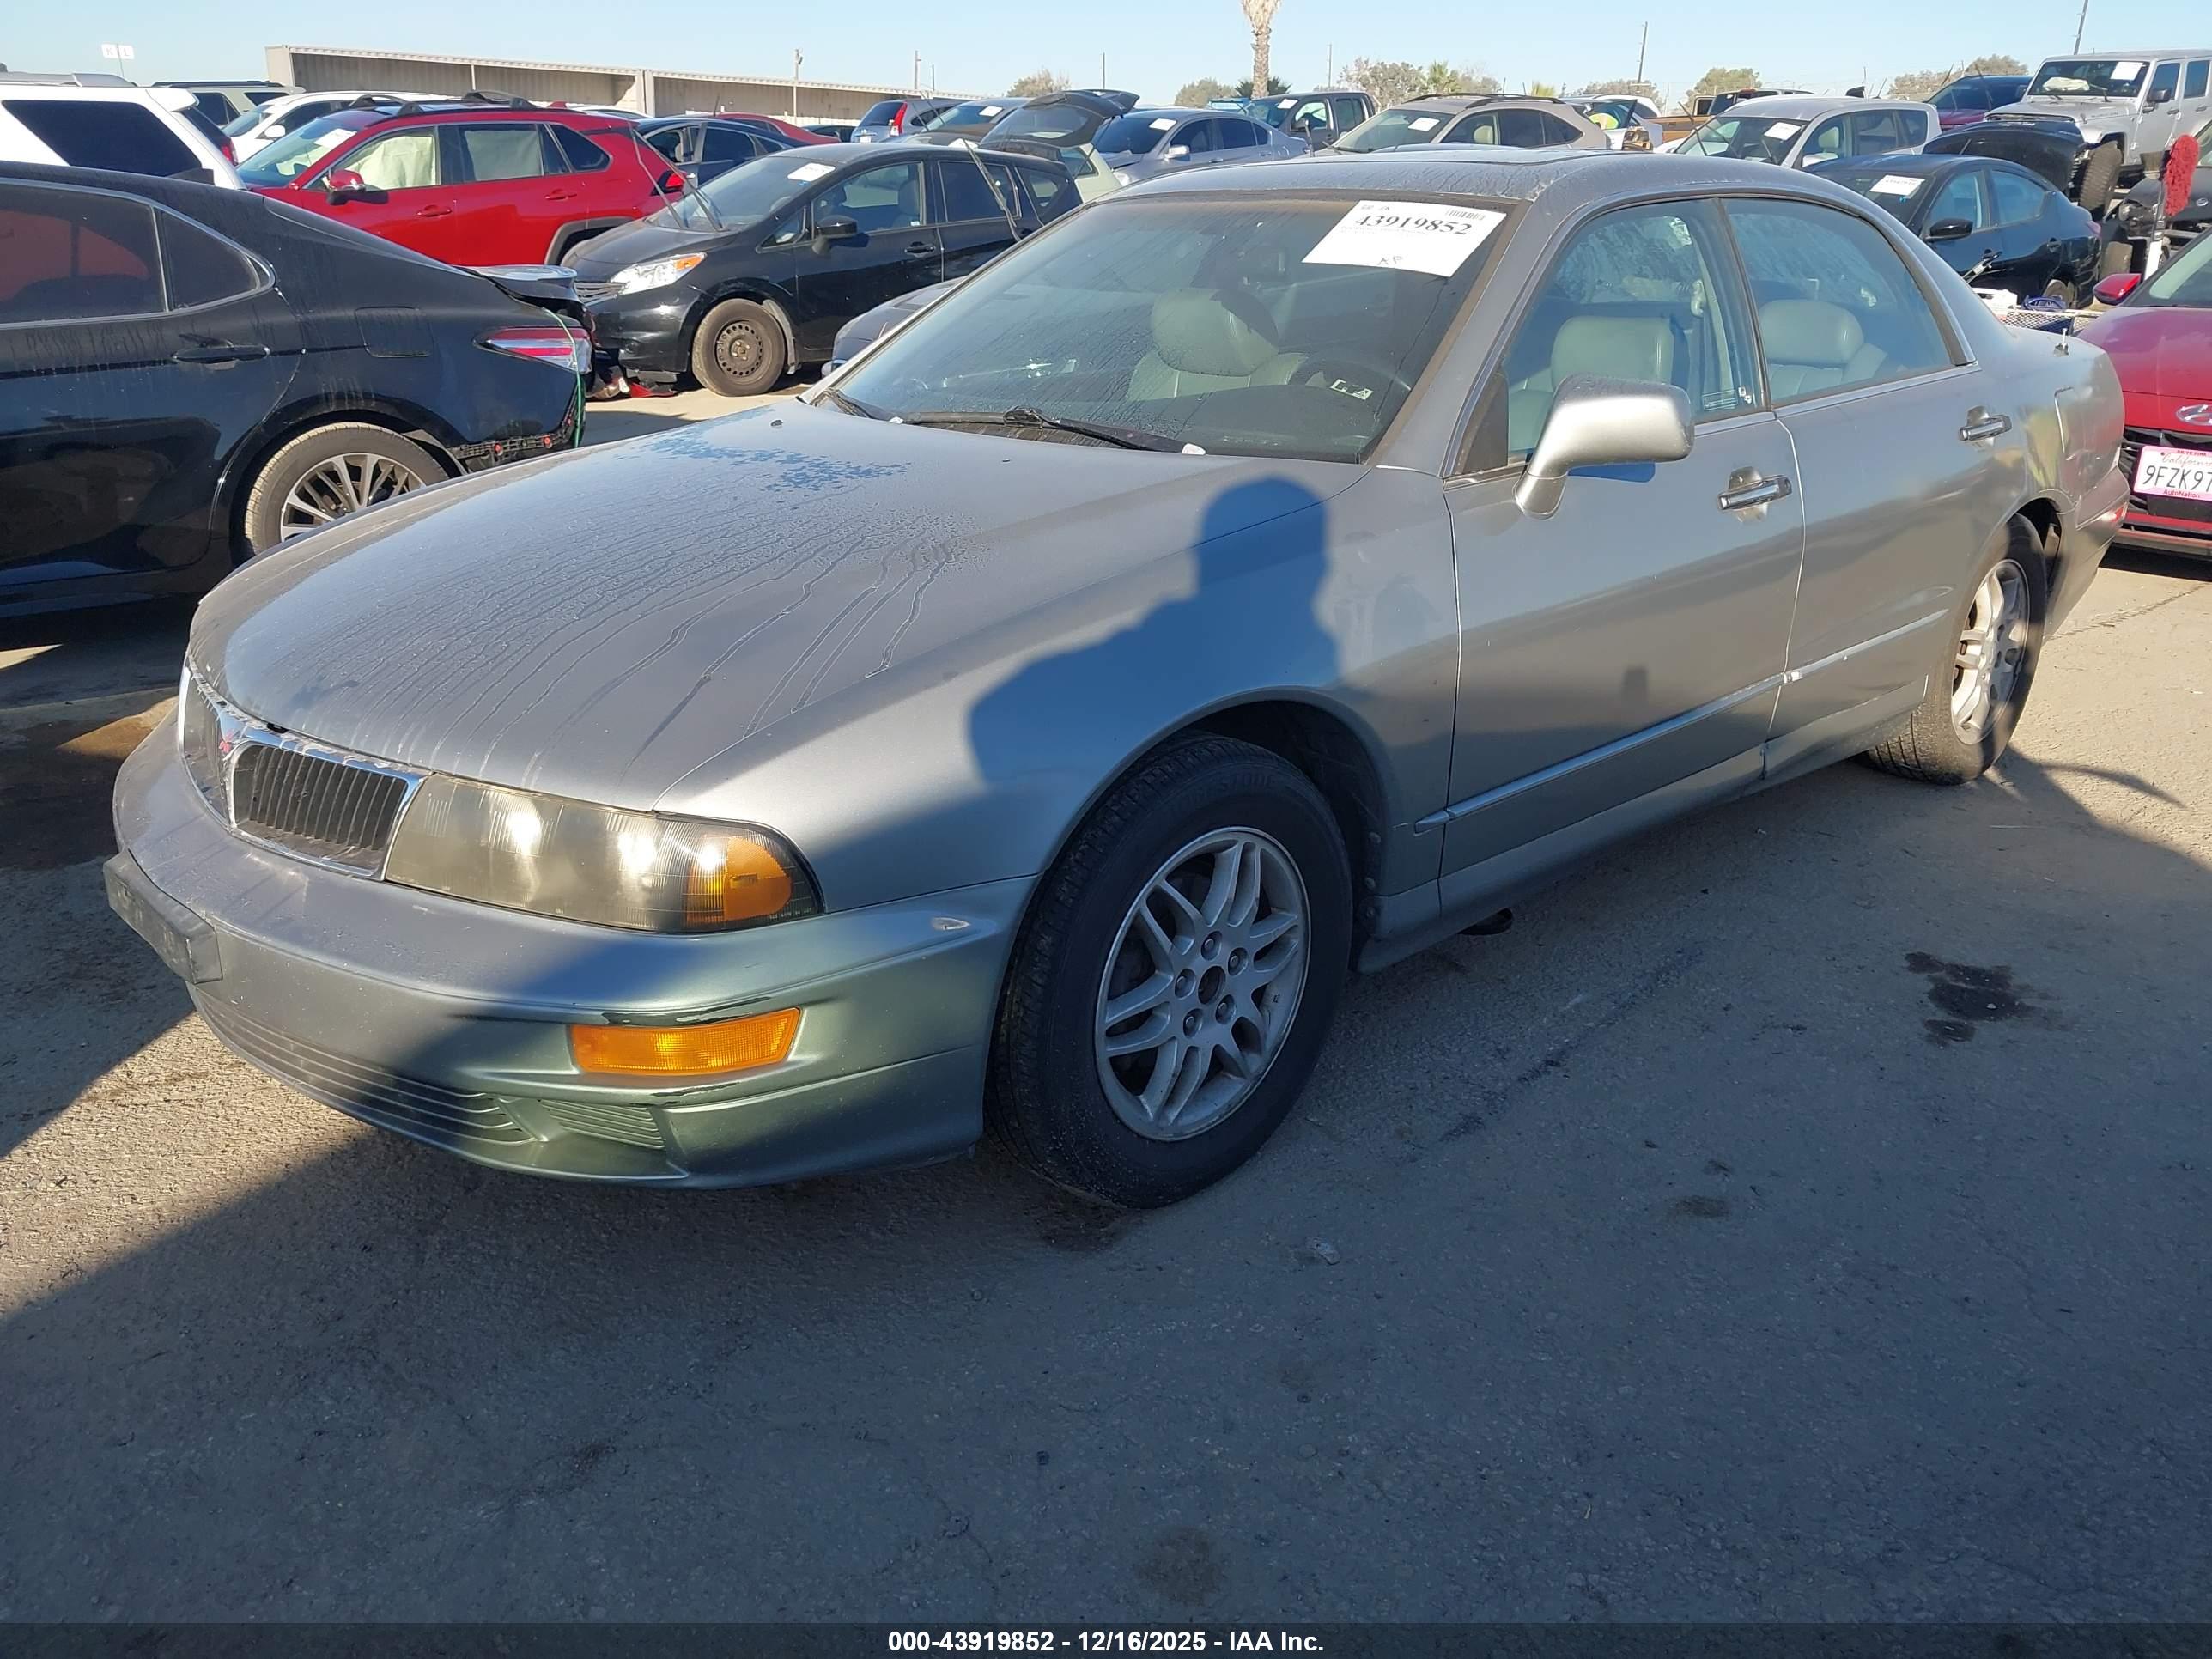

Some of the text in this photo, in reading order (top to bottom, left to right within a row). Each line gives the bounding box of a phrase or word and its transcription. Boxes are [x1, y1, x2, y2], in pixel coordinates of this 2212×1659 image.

[106, 47, 113, 56] K
[123, 47, 131, 57] L
[1354, 214, 1473, 235] 43919852
[2163, 489, 2201, 499] AutoNation
